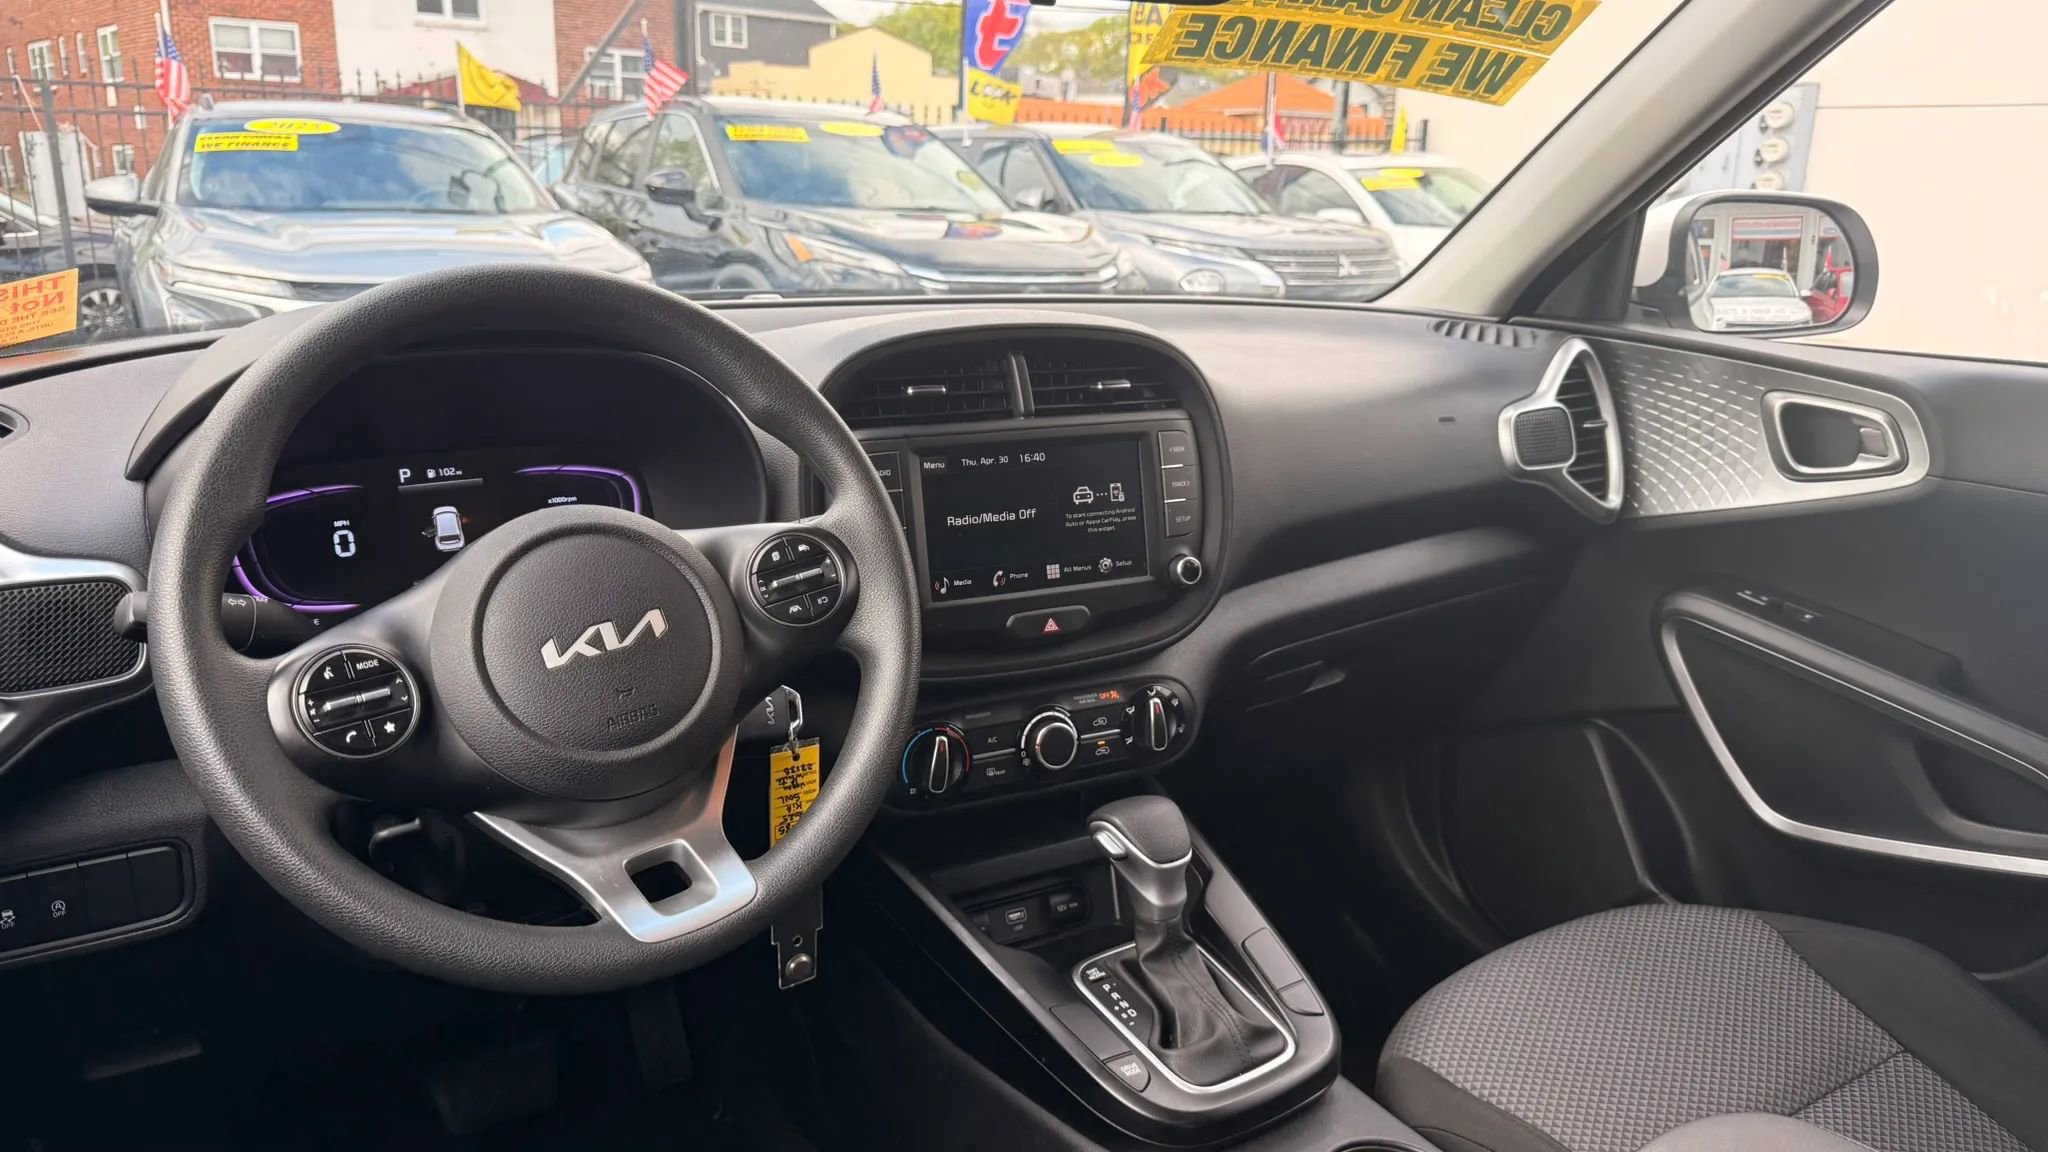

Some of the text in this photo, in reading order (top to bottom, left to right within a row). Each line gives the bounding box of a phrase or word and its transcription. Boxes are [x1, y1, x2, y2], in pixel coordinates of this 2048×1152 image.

[923, 461, 945, 470] Menu
[998, 455, 1009, 464] 30
[1019, 452, 1046, 463] 16:40
[399, 469, 411, 483] P
[548, 496, 577, 504] x1000rpm
[947, 508, 1037, 527] Radio/Media Off
[333, 519, 350, 527] MPH
[333, 529, 356, 558] 0
[1063, 563, 1092, 573] All Menus
[1115, 558, 1133, 568] Setup
[1009, 571, 1029, 580] Phone
[953, 577, 972, 586] Media
[541, 608, 668, 669] KIA
[356, 659, 379, 670] MODE
[606, 703, 660, 731] AIRBAG
[53, 910, 66, 918] OFF
[1, 922, 15, 930] OFF
